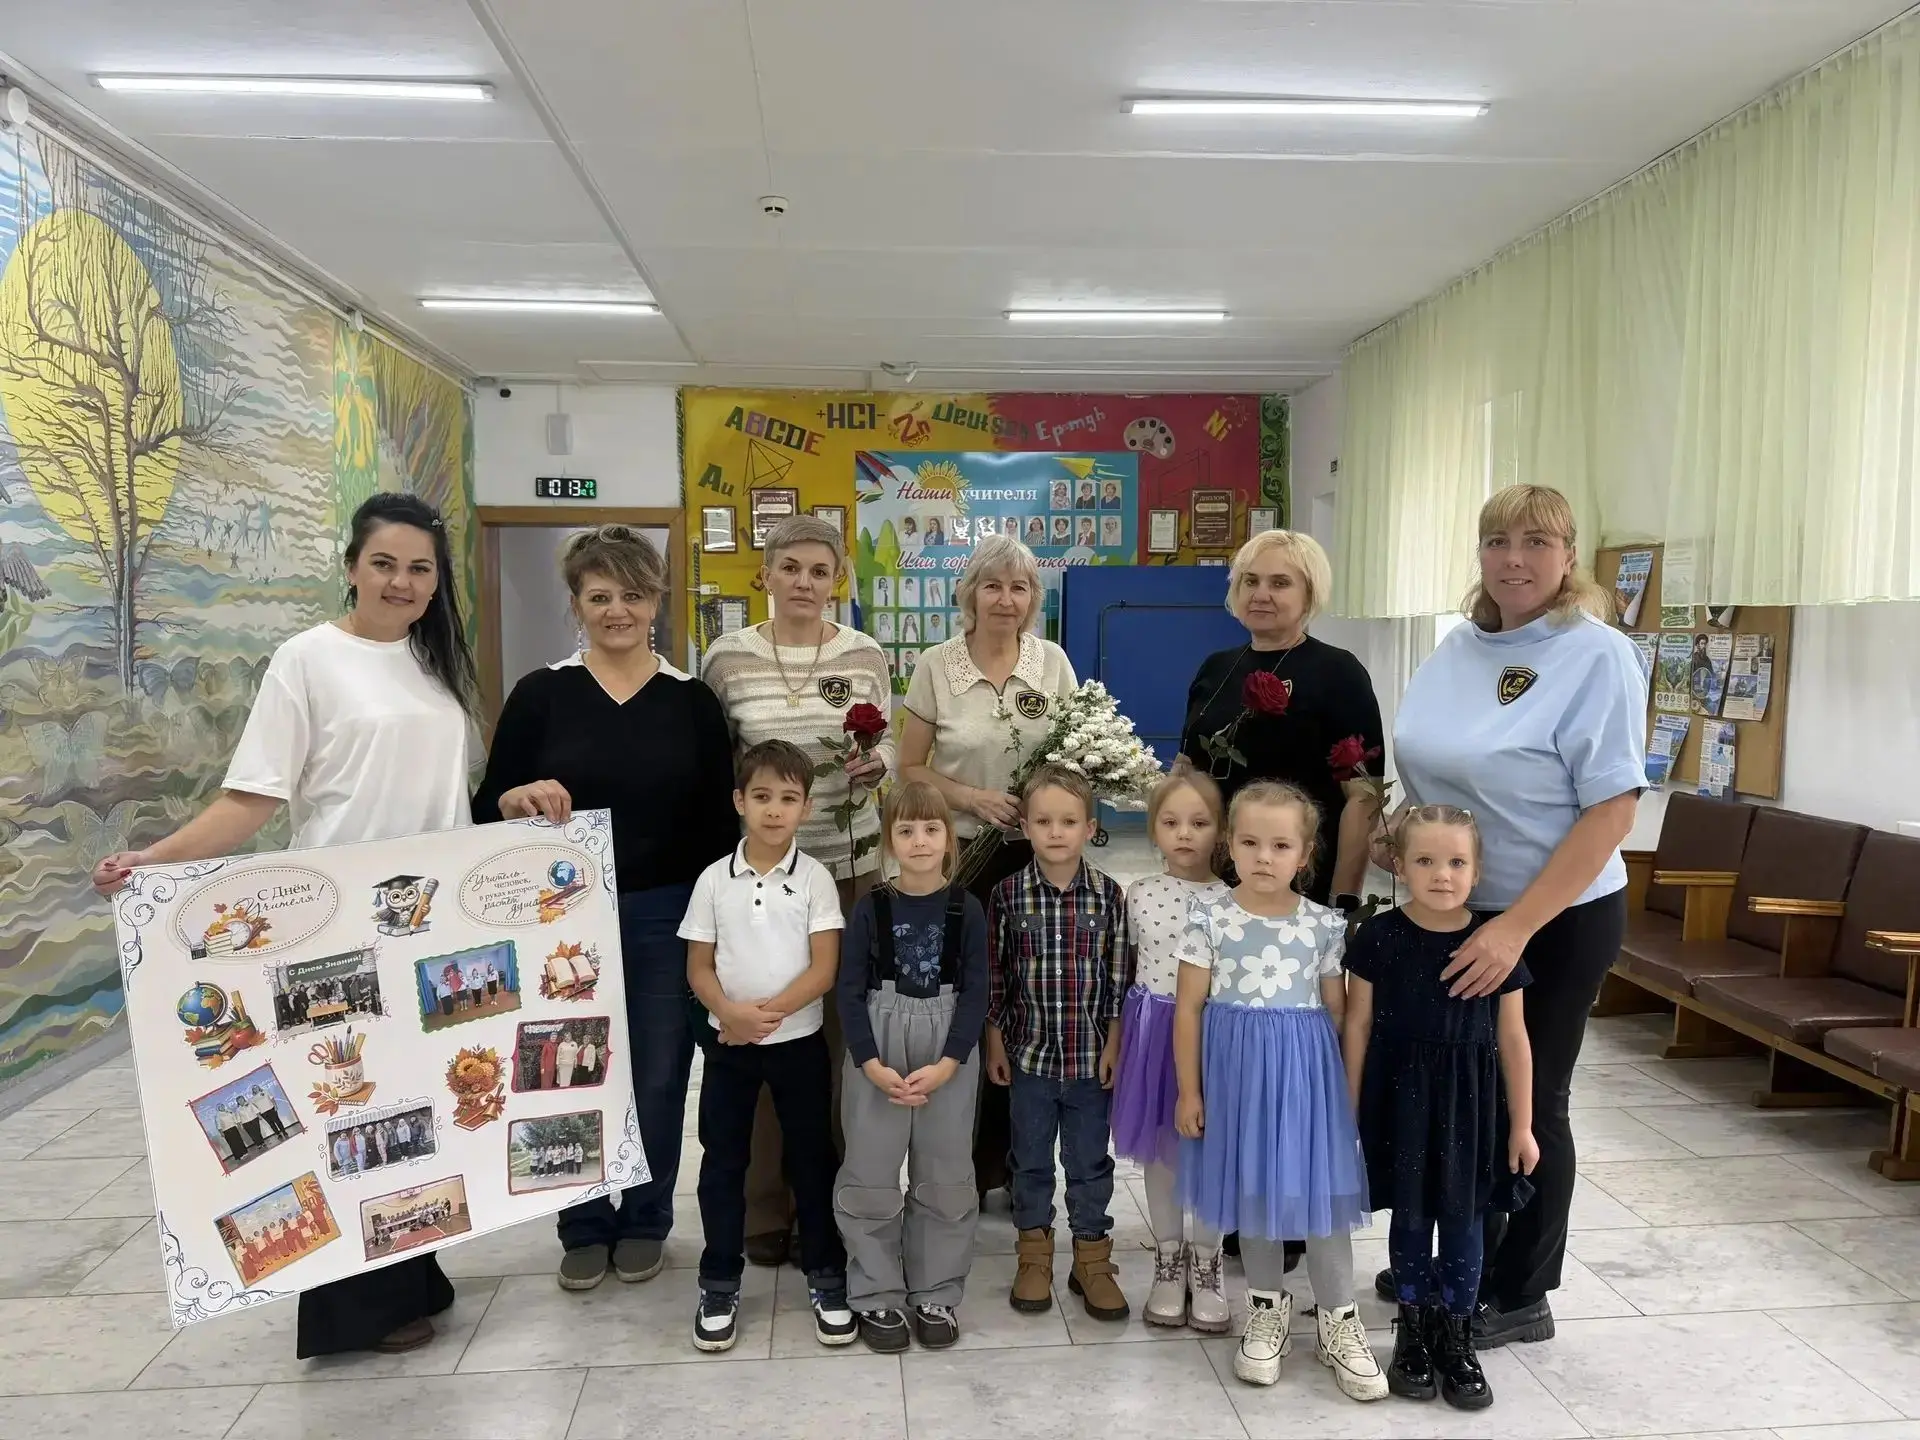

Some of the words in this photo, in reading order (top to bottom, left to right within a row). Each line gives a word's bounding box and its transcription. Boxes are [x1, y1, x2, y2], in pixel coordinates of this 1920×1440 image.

[724, 405, 826, 457] ABCDE
[894, 413, 931, 444] Zn
[698, 462, 734, 497] Au
[896, 480, 953, 501] Наши
[958, 488, 1038, 504] учителя
[896, 550, 936, 569] Ими
[272, 883, 312, 900] Днём
